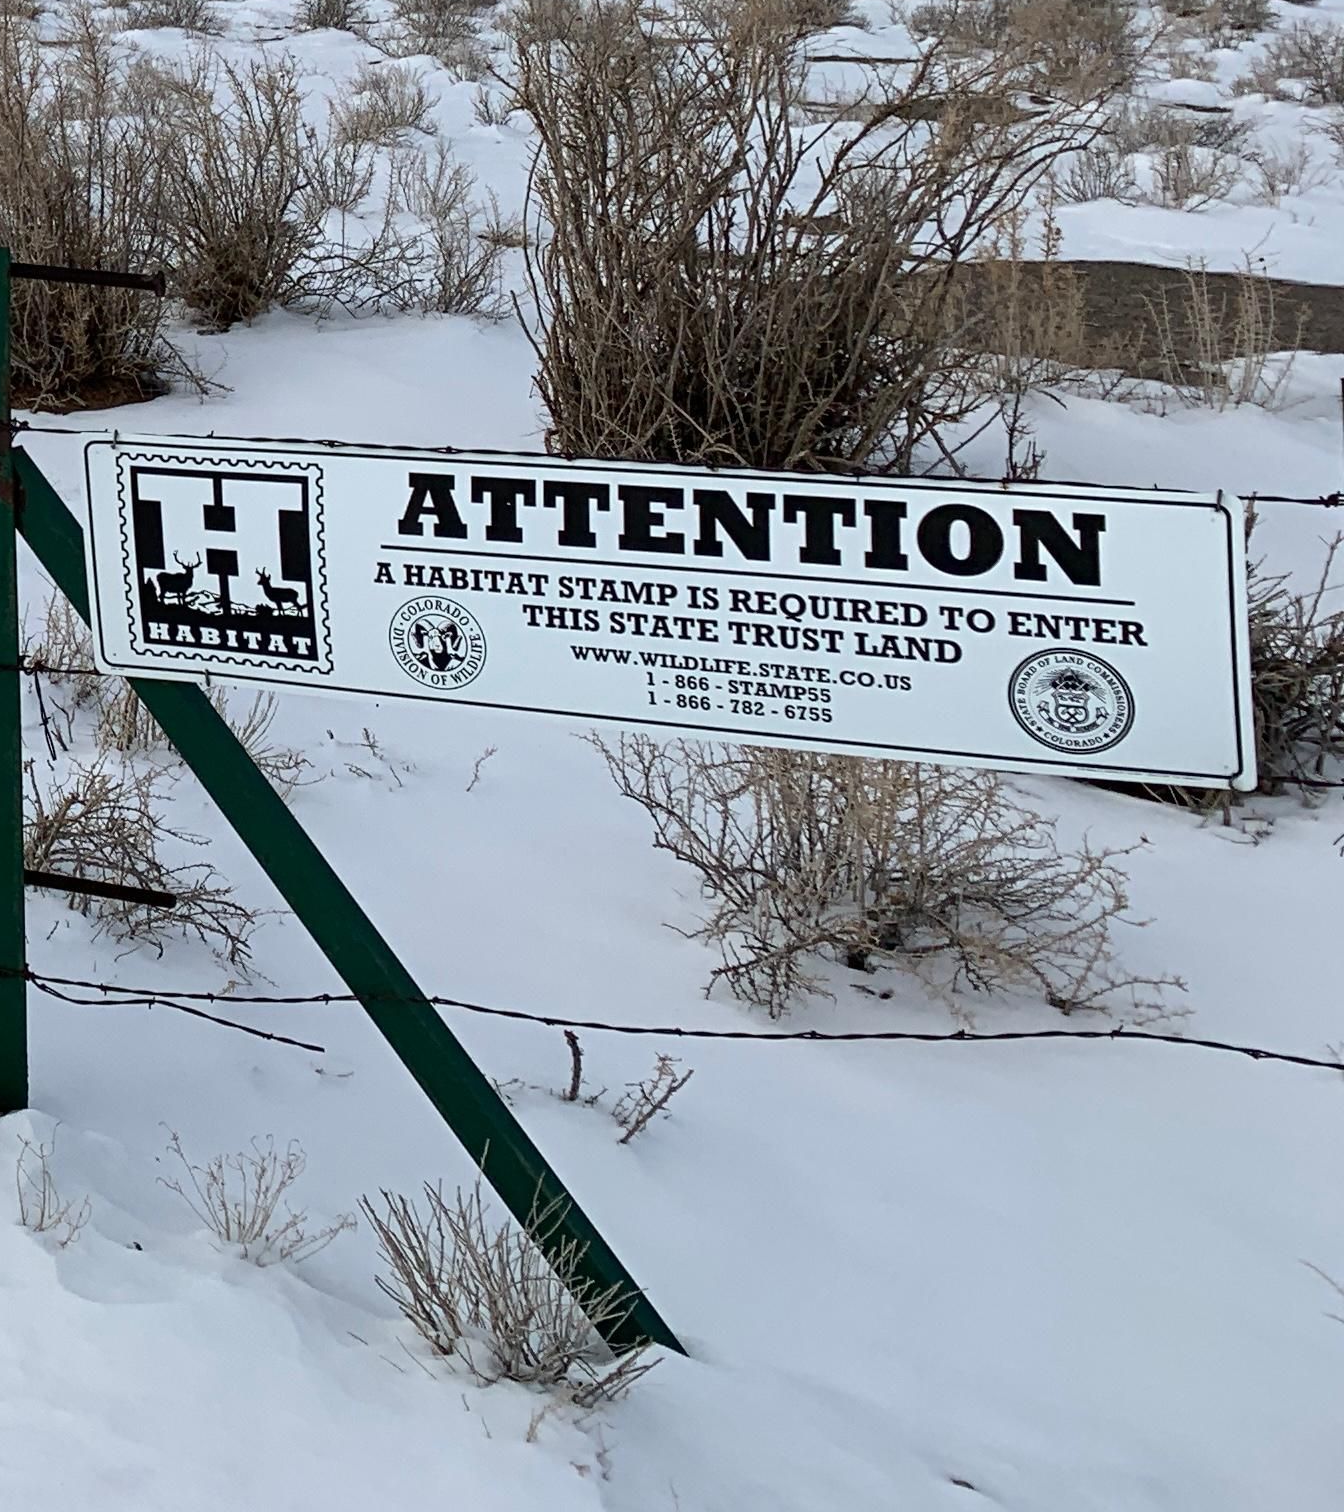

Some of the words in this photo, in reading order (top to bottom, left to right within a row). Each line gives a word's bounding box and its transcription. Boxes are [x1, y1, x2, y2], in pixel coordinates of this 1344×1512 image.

[398, 472, 1107, 586] ATTENTION
[374, 562, 396, 584] A
[403, 564, 549, 596] HABITAT
[559, 575, 678, 606] STAMP
[687, 586, 720, 610] IS
[729, 589, 928, 627] REQUIRED
[940, 606, 996, 634] TO
[1008, 611, 1149, 647] ENTER
[400, 599, 470, 626] COLORADO
[148, 622, 312, 655] HABITAT
[523, 604, 600, 632] THIS
[609, 611, 719, 642] STATE
[728, 620, 844, 654] TRUST
[855, 632, 962, 663] LAND
[393, 628, 429, 680] DIVISION
[431, 674, 448, 686] OF
[450, 633, 483, 684] WILDLIFE
[570, 645, 912, 691] WWW.WILDLIFE.STATE.CO.US
[1017, 666, 1038, 695] BOARD
[1037, 657, 1051, 668] OF
[1054, 655, 1084, 665] LAND
[1043, 731, 1104, 747] COLORADO
